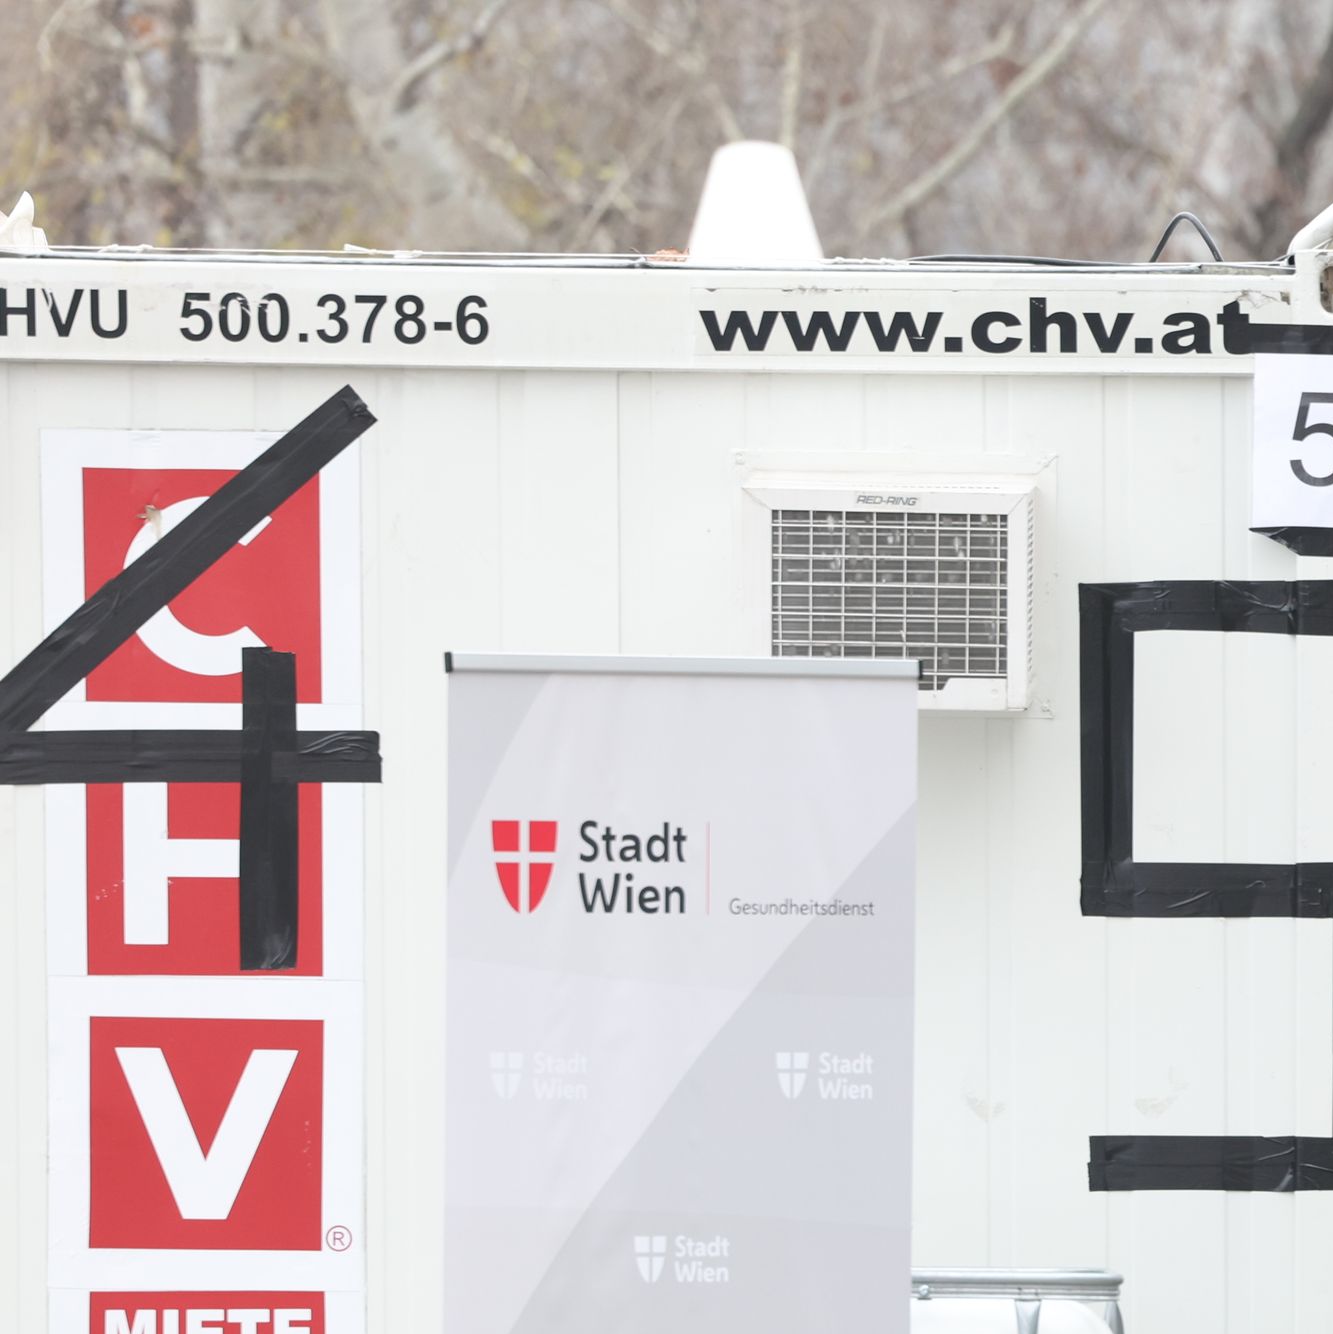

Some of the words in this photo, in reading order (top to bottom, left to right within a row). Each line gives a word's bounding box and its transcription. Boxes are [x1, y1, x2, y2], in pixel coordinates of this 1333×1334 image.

[180, 292, 489, 345] 500.378-6
[699, 297, 1249, 355] www.chv.at
[856, 494, 919, 507] RED-RING
[579, 820, 687, 863] Stadt
[578, 872, 686, 914] Wien
[729, 898, 875, 916] Gesundheitsdienst
[533, 1052, 588, 1074] Stadt
[818, 1052, 873, 1074] Stadt
[533, 1078, 588, 1100] Wien
[818, 1078, 873, 1100] Wien
[674, 1235, 730, 1258] Stadt
[674, 1262, 730, 1283] Wien
